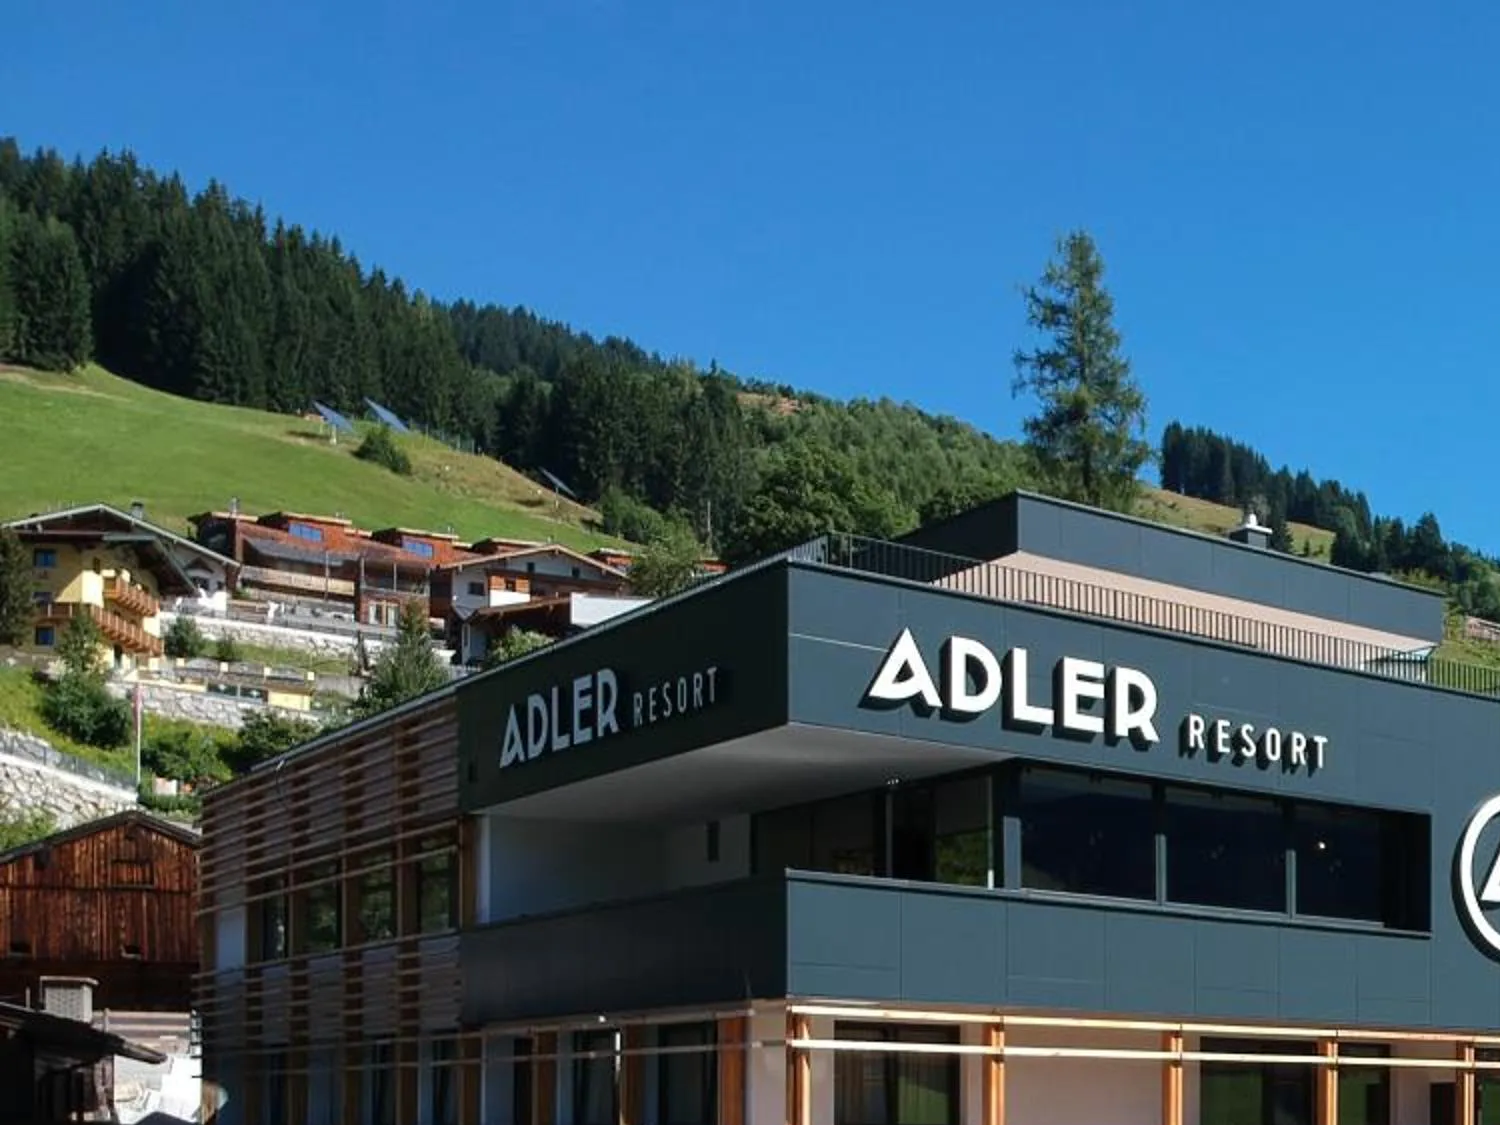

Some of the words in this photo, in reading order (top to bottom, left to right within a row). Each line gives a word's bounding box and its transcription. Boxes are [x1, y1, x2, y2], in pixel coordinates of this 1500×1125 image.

[500, 667, 620, 769] ADLER
[632, 666, 718, 728] RESORT
[869, 626, 1161, 743] ADLER
[1187, 714, 1329, 770] RESORT
